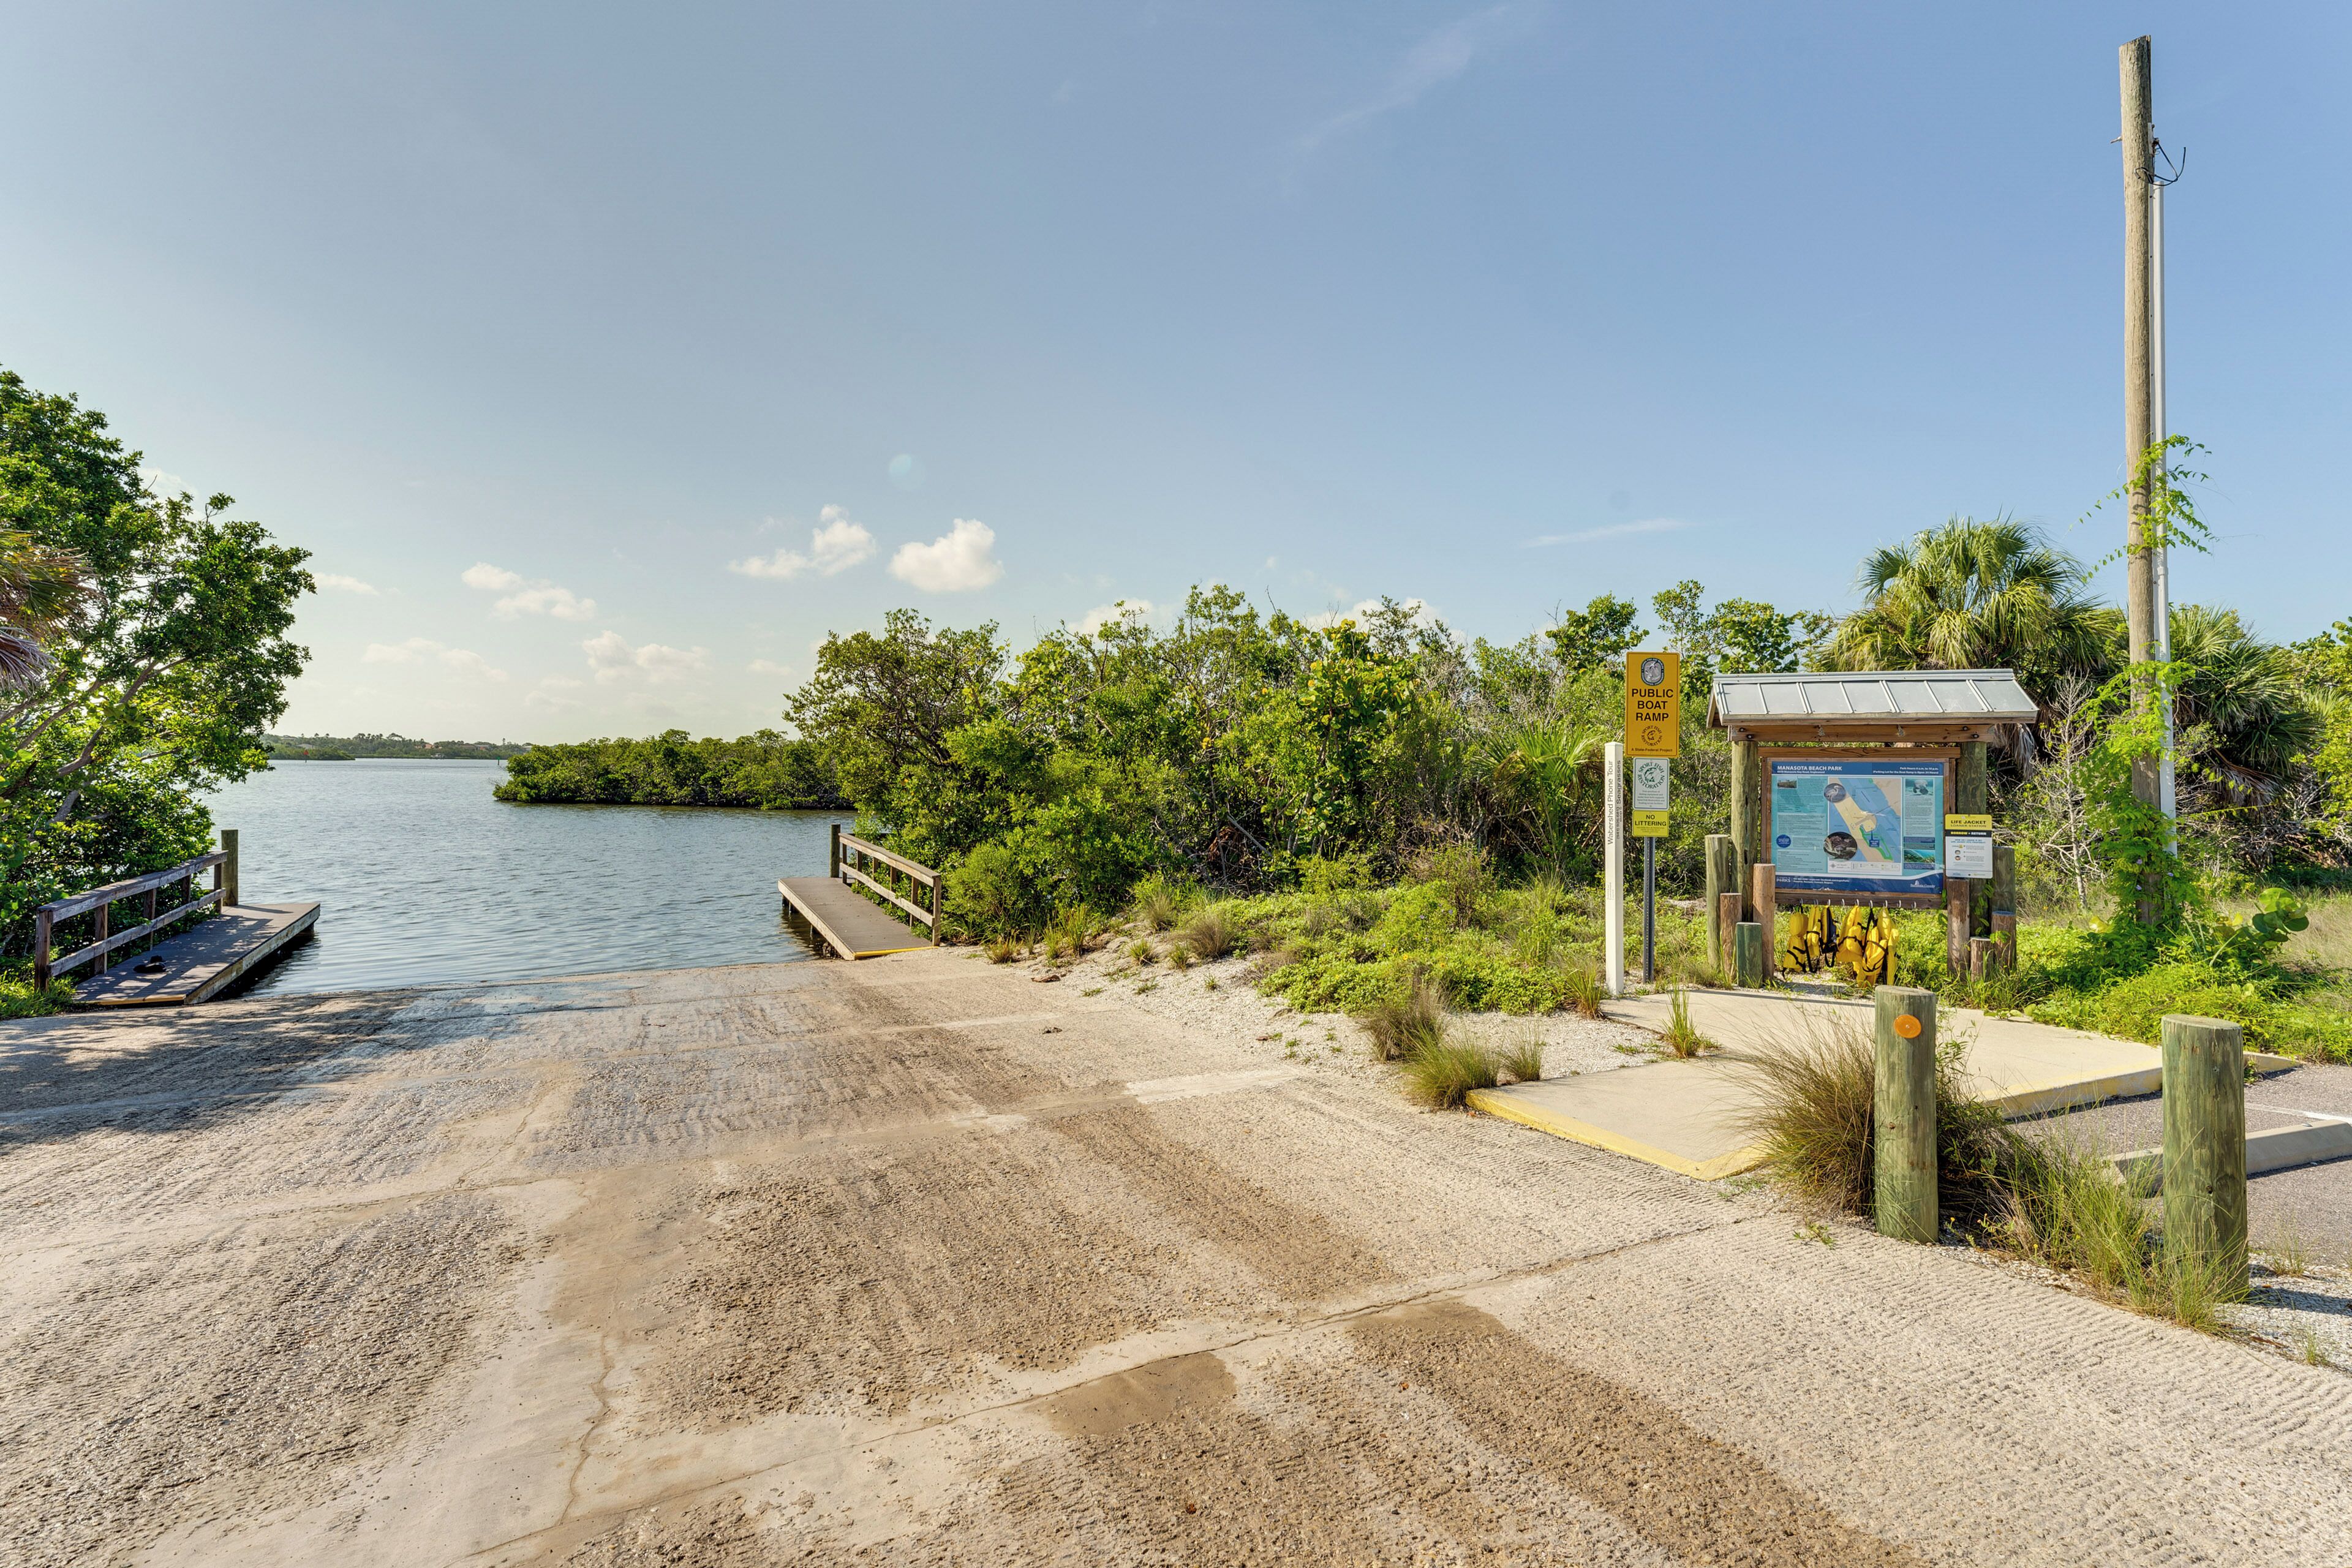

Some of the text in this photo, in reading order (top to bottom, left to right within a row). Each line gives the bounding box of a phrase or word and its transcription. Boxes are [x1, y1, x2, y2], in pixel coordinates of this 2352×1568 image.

[1632, 688, 1673, 698] PUBLIC
[1637, 700, 1668, 709] BOAT
[1636, 712, 1669, 722] RAMP
[1642, 725, 1654, 734] SPORT
[1642, 735, 1662, 746] RESTORATION
[1638, 762, 1665, 774] SPORT FISH
[1638, 774, 1665, 789] RESTORATION
